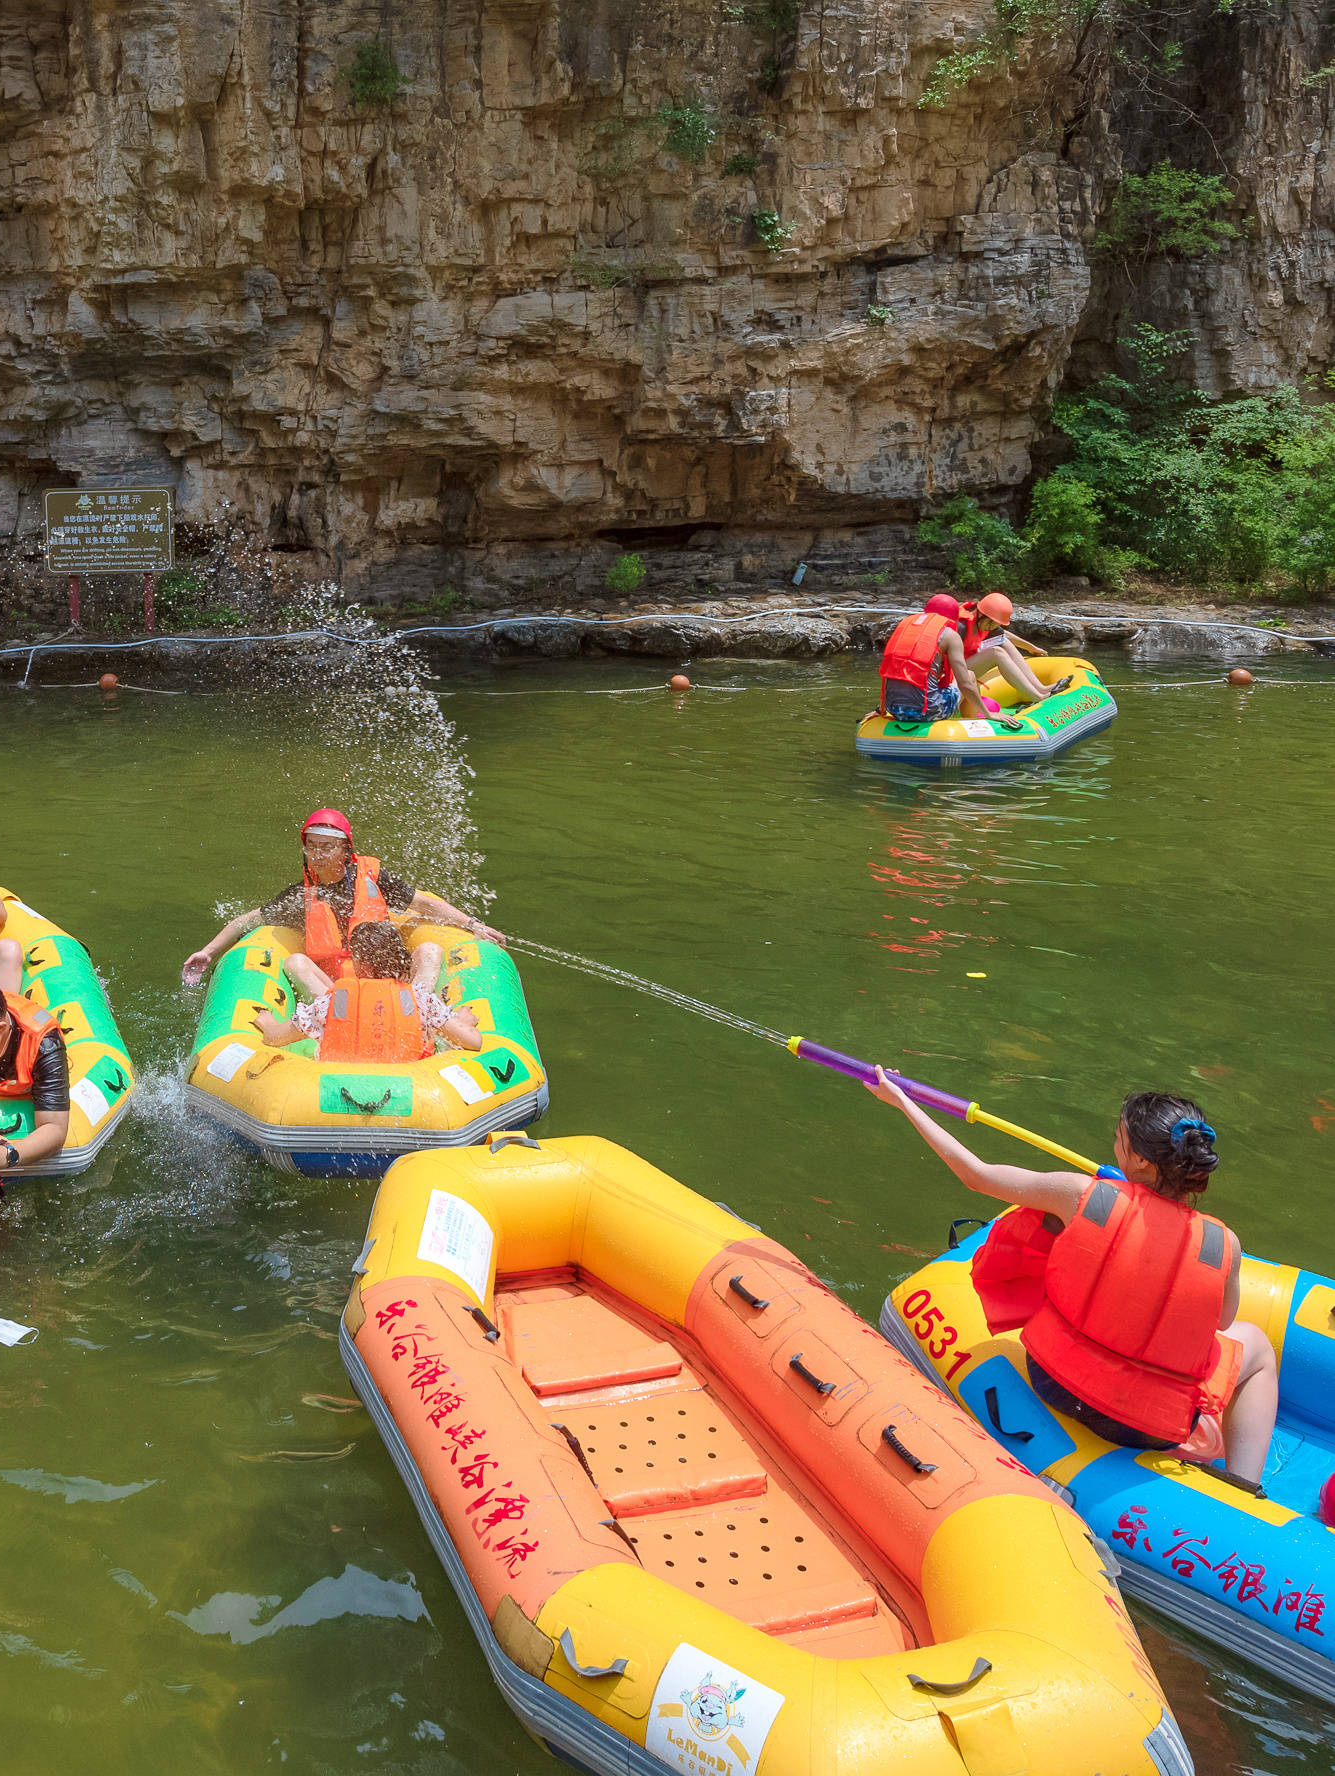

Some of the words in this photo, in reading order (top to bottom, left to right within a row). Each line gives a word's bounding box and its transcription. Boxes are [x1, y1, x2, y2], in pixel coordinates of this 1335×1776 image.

[902, 1289, 972, 1382] 0531
[1111, 1505, 1326, 1637] 乐谷银滩
[667, 1727, 734, 1776] LeManDi
